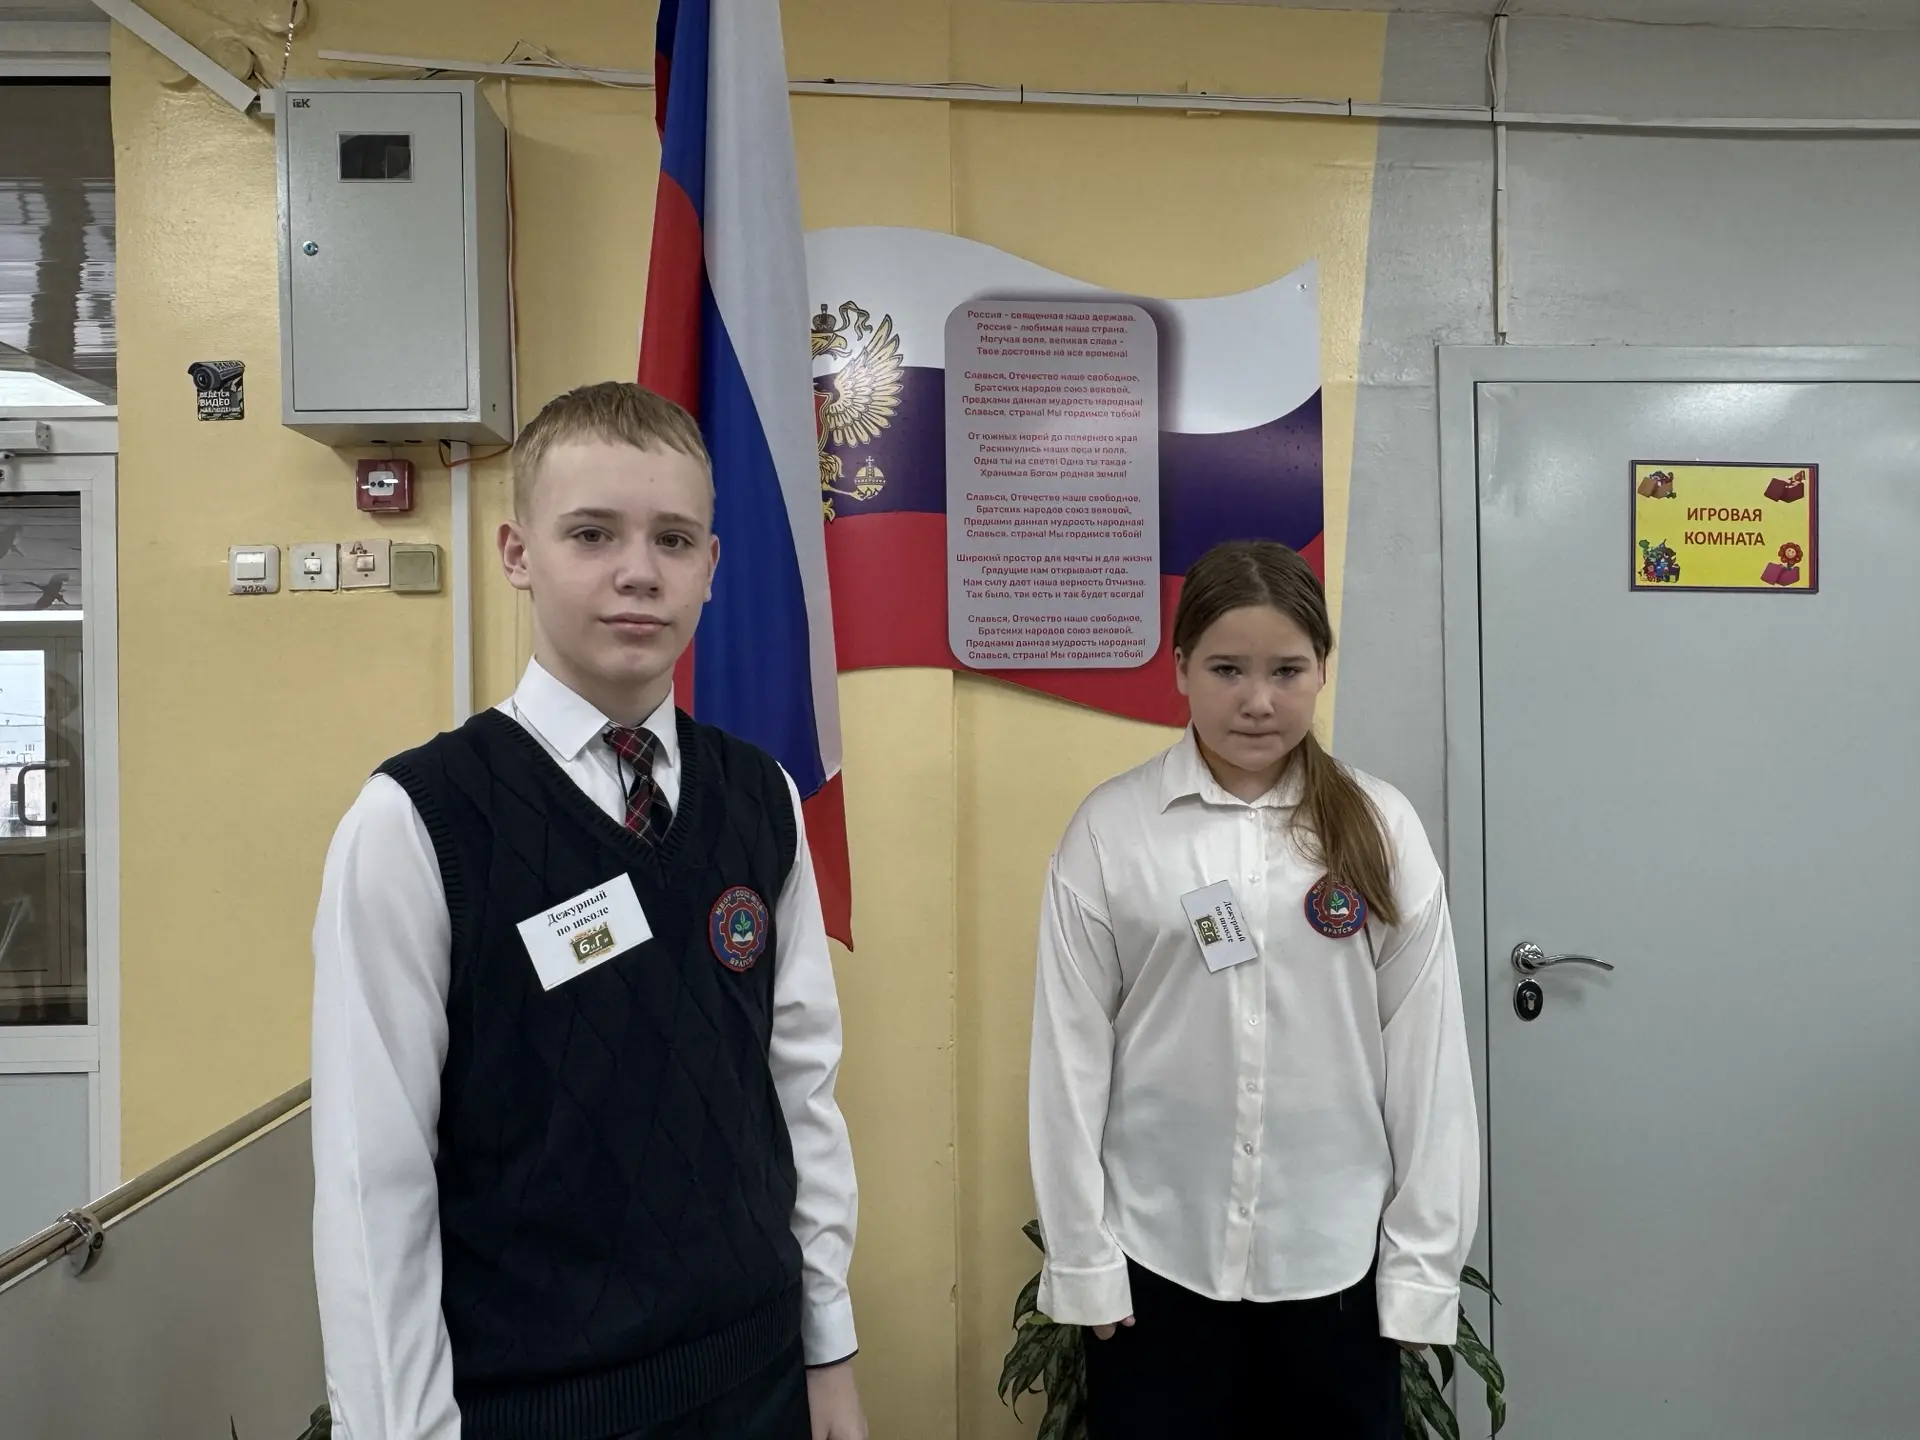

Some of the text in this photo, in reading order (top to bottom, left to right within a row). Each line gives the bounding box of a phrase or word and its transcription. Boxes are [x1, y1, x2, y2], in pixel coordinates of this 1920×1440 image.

[199, 398, 230, 407] ВИДЕО
[1687, 507, 1762, 522] ИГРОВАЯ
[1684, 531, 1765, 546] КОМНАТА
[547, 889, 608, 927] Дежурный
[557, 905, 610, 937] по школе
[1223, 900, 1247, 943] Дежурный
[1215, 906, 1234, 943] по школе
